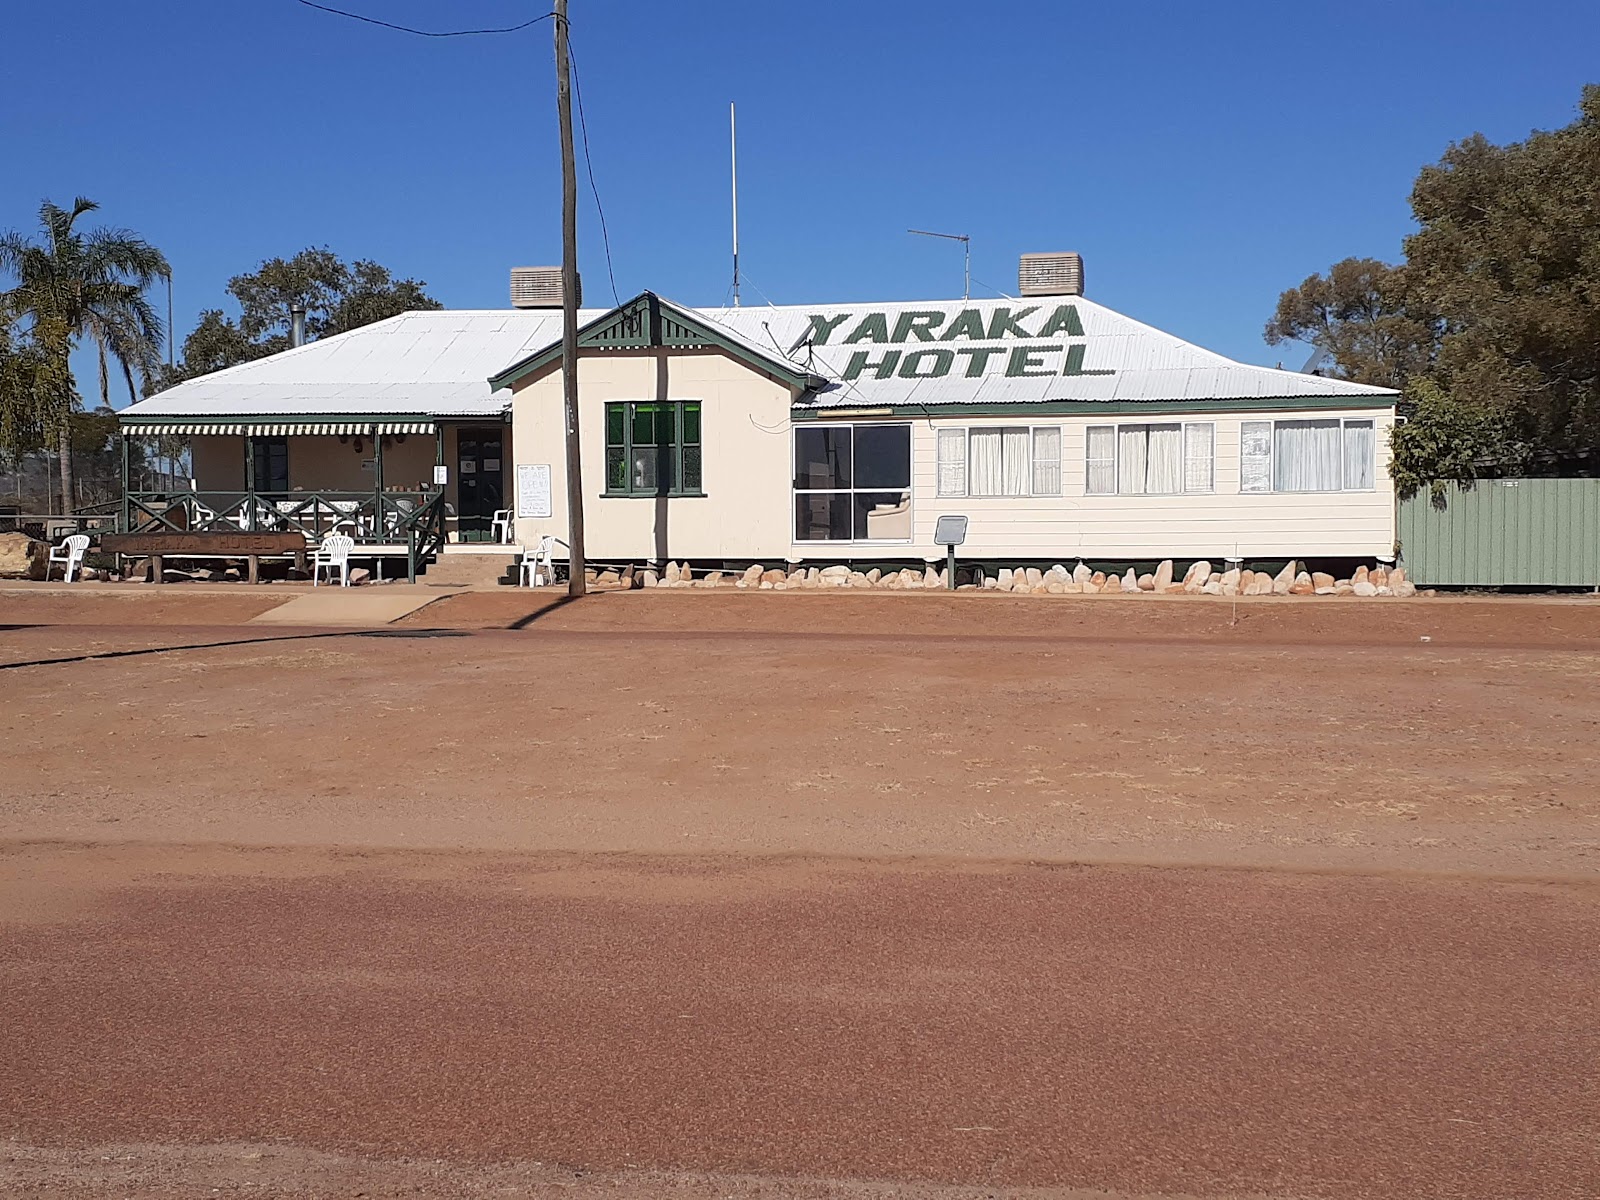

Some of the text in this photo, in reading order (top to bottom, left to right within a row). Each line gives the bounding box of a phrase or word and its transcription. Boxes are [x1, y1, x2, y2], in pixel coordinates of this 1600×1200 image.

[808, 304, 1086, 346] YARAKA
[841, 344, 1116, 381] HOTEL
[218, 535, 275, 550] HOTEL
